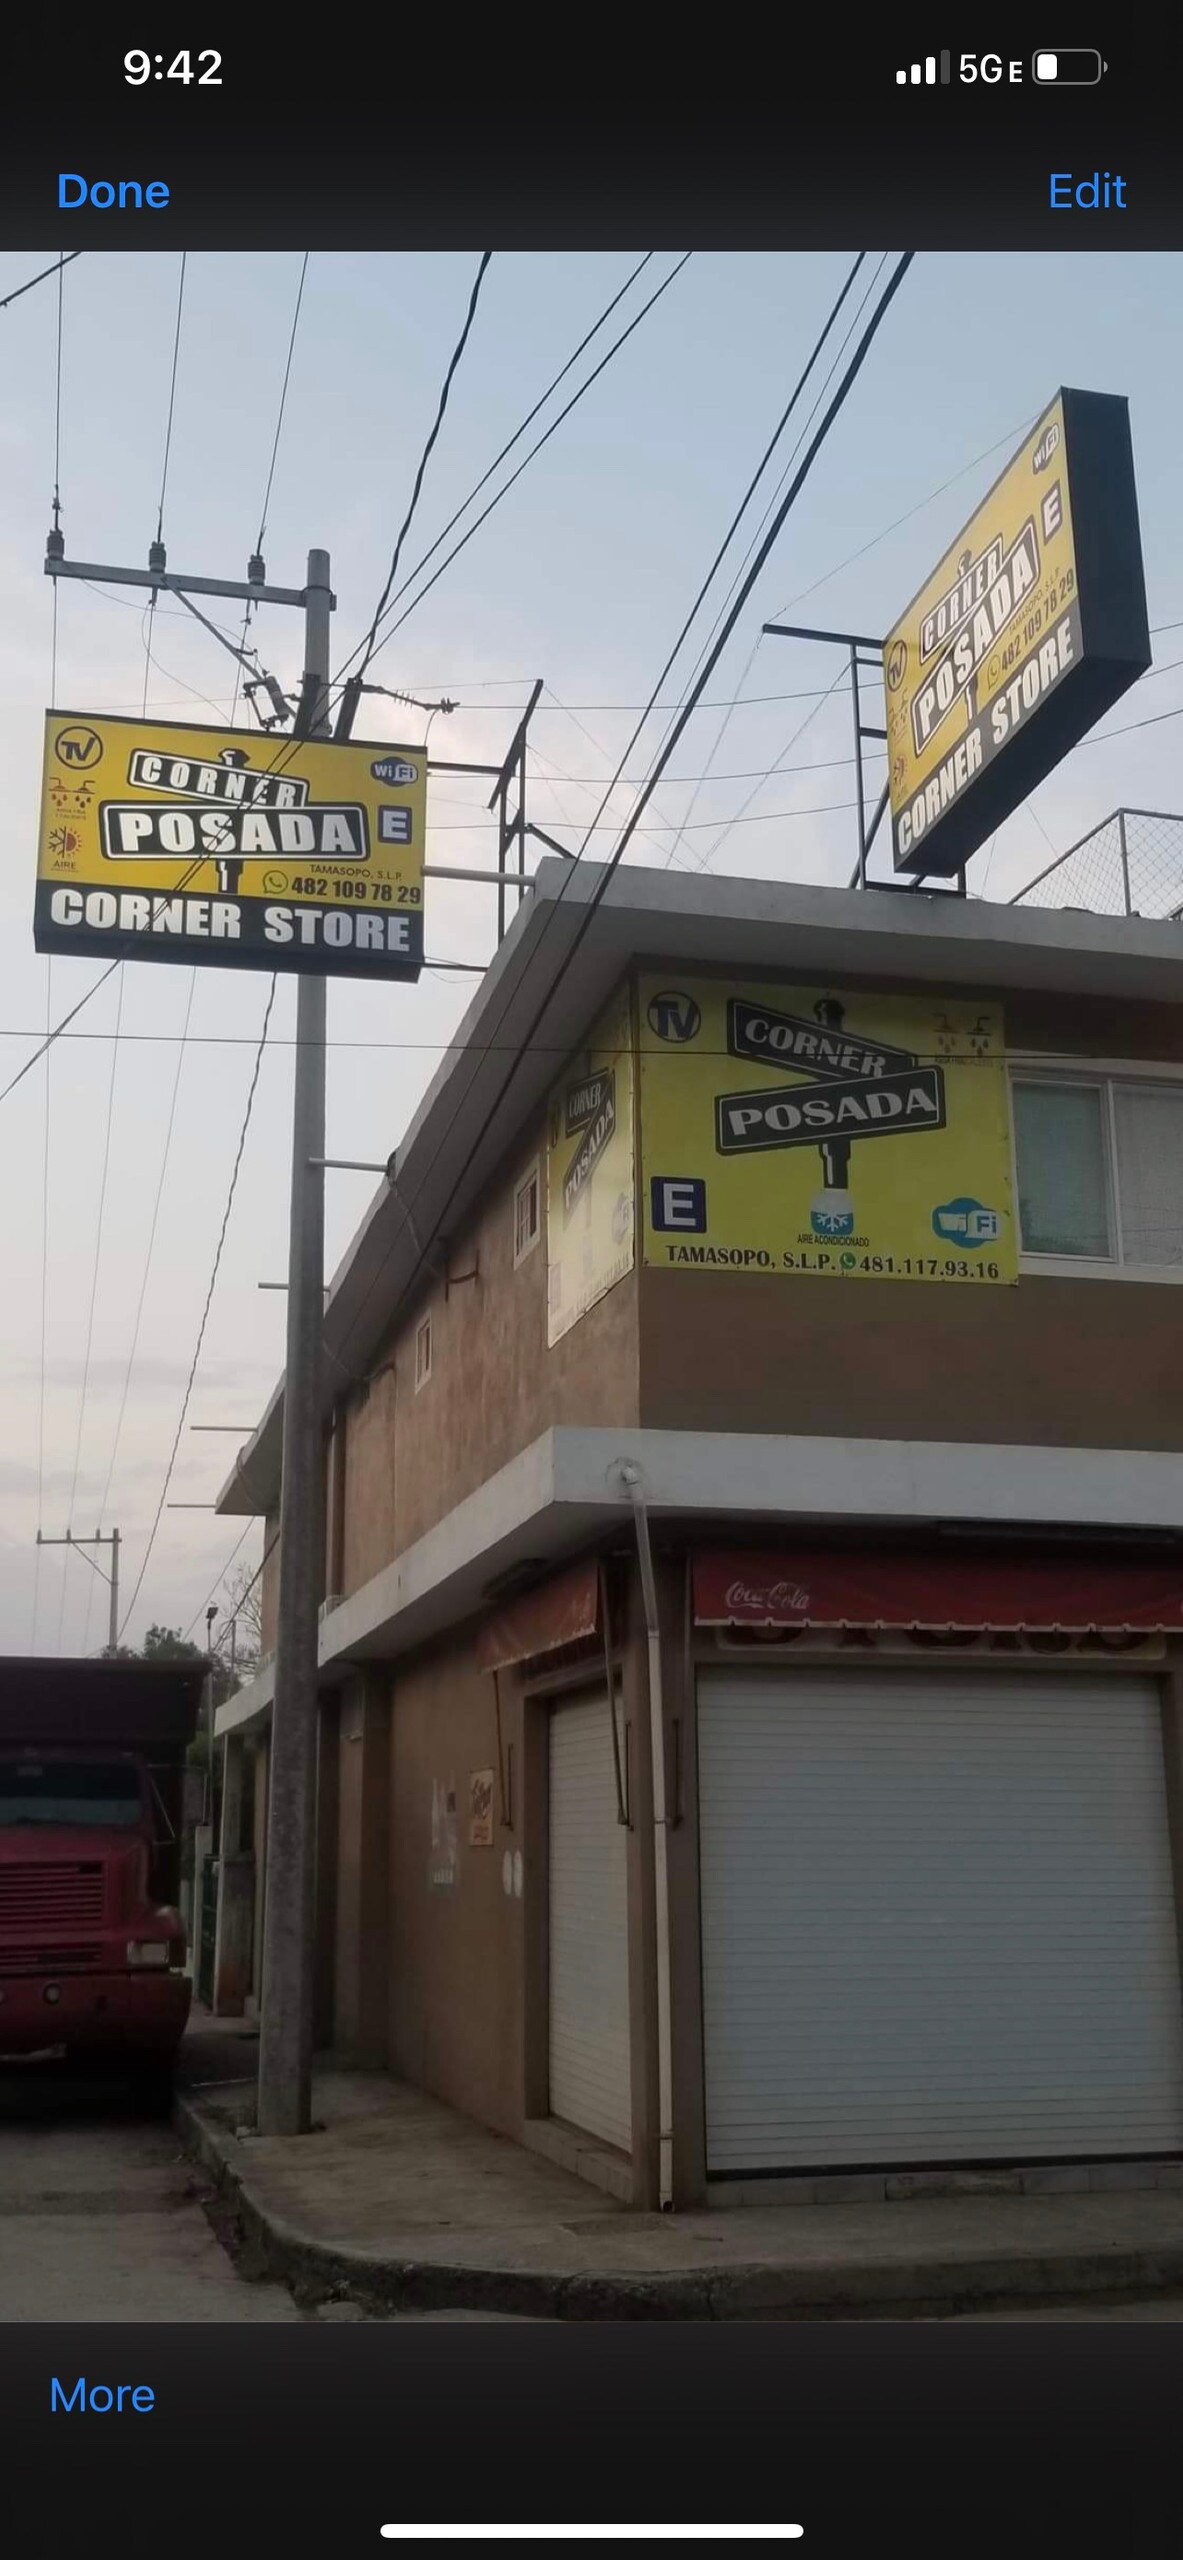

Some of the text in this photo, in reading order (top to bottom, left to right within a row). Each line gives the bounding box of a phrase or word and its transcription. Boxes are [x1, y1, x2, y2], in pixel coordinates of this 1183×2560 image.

[1043, 488, 1060, 538] E
[925, 551, 997, 652] CORNER
[1001, 568, 1075, 671] 482 109 78 29
[919, 543, 1034, 739] POSADA
[60, 736, 96, 762] TV
[898, 616, 1074, 856] CORNER STORE
[141, 755, 296, 808] CORNER
[118, 812, 357, 853] POSADA
[382, 809, 408, 840] E
[54, 860, 77, 870] AIRE
[309, 864, 374, 879] TAMASOPO,
[291, 877, 421, 903] 482 109 78 29
[51, 888, 410, 952] CORNER STORE
[651, 1002, 698, 1039] TV
[744, 1018, 887, 1079] CORNER
[568, 1081, 601, 1120] CORNER
[727, 1087, 938, 1136] POSADA
[564, 1100, 615, 1210] POSADA
[663, 1183, 697, 1226] E
[665, 1245, 999, 1279] TAMASOPO, S.L.P. 481.117.93.16
[797, 1234, 870, 1248] AIRE ACONDICIONADO
